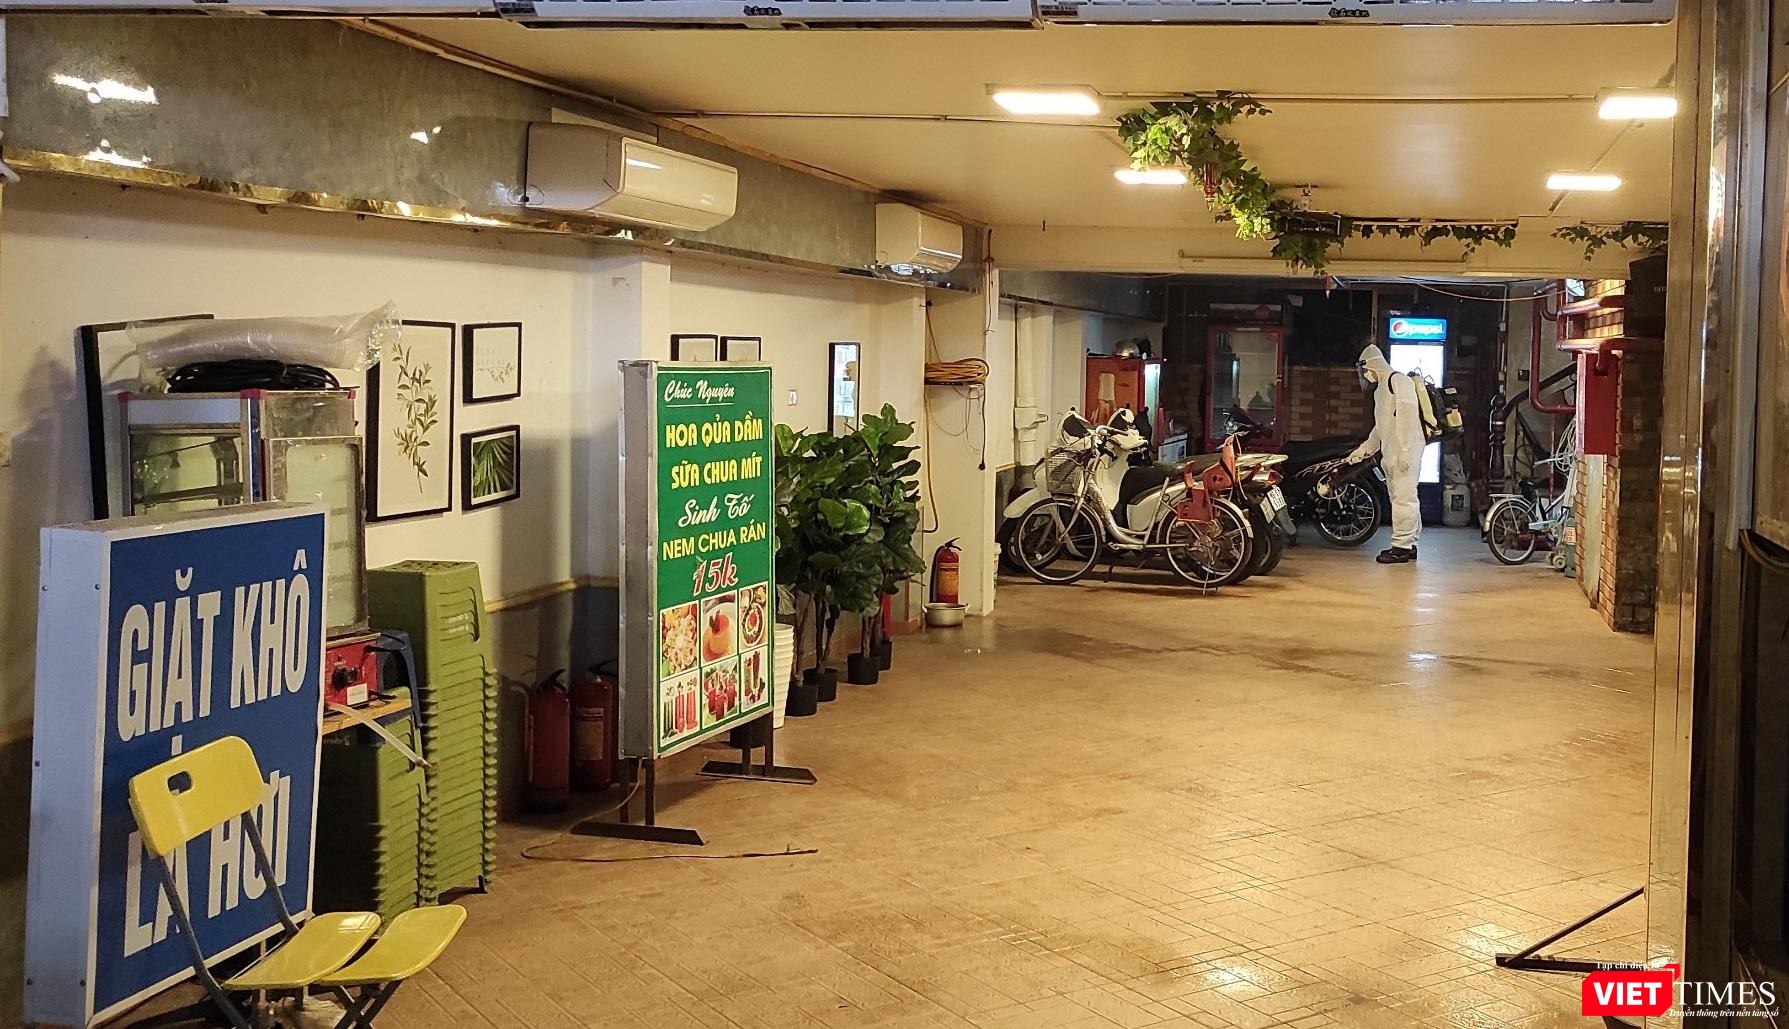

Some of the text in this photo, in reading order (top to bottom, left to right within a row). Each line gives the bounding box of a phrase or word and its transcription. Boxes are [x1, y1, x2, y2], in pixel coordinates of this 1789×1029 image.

[664, 379, 693, 402] Chúc
[665, 410, 763, 448] HOA QỦA DẦM
[671, 452, 762, 489] SỮA CHUA MÍT
[678, 493, 755, 528] Sinh Tố
[662, 519, 766, 561] NEM CHUA RÁN
[692, 552, 739, 597] 15k
[231, 549, 310, 709] KHÔ
